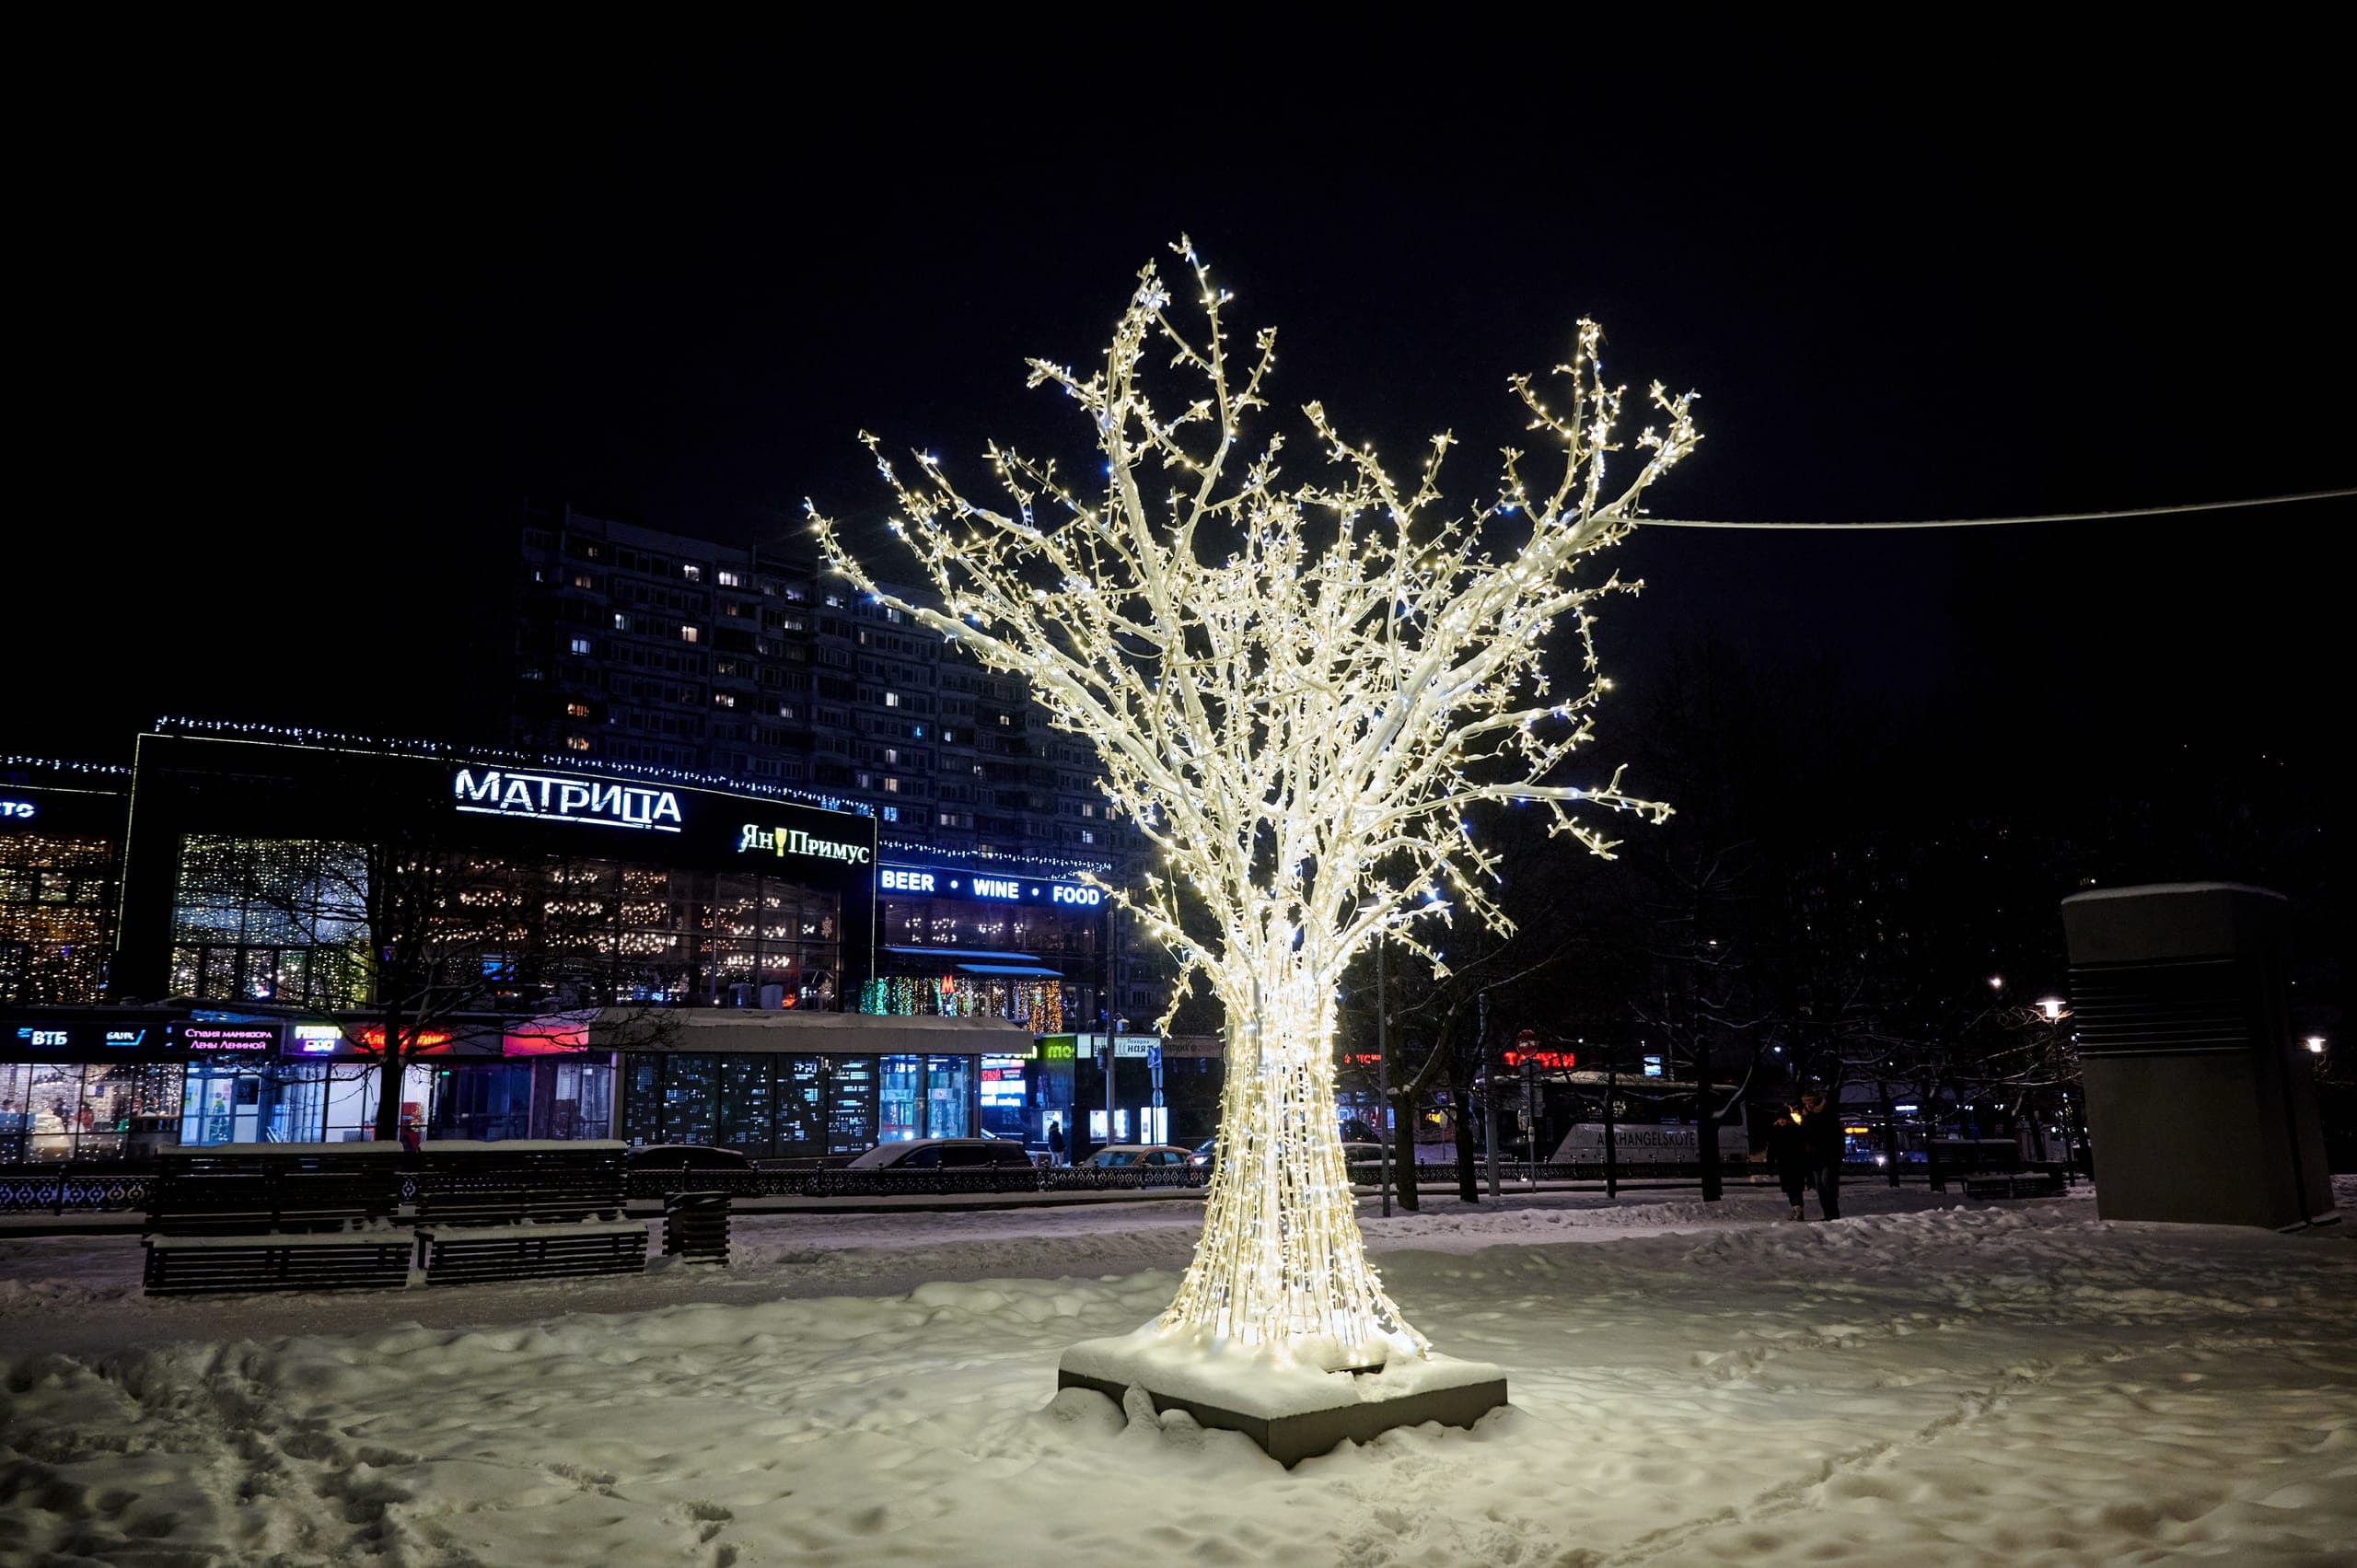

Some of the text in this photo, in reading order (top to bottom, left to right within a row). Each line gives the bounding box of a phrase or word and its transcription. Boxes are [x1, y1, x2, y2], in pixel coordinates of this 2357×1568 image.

[456, 770, 681, 824] МАТРИЦА
[881, 870, 1100, 906] BEER WINE FOOD
[31, 1030, 68, 1046] ВТБ
[1596, 1131, 1696, 1146] AKHANGELSKOYE
